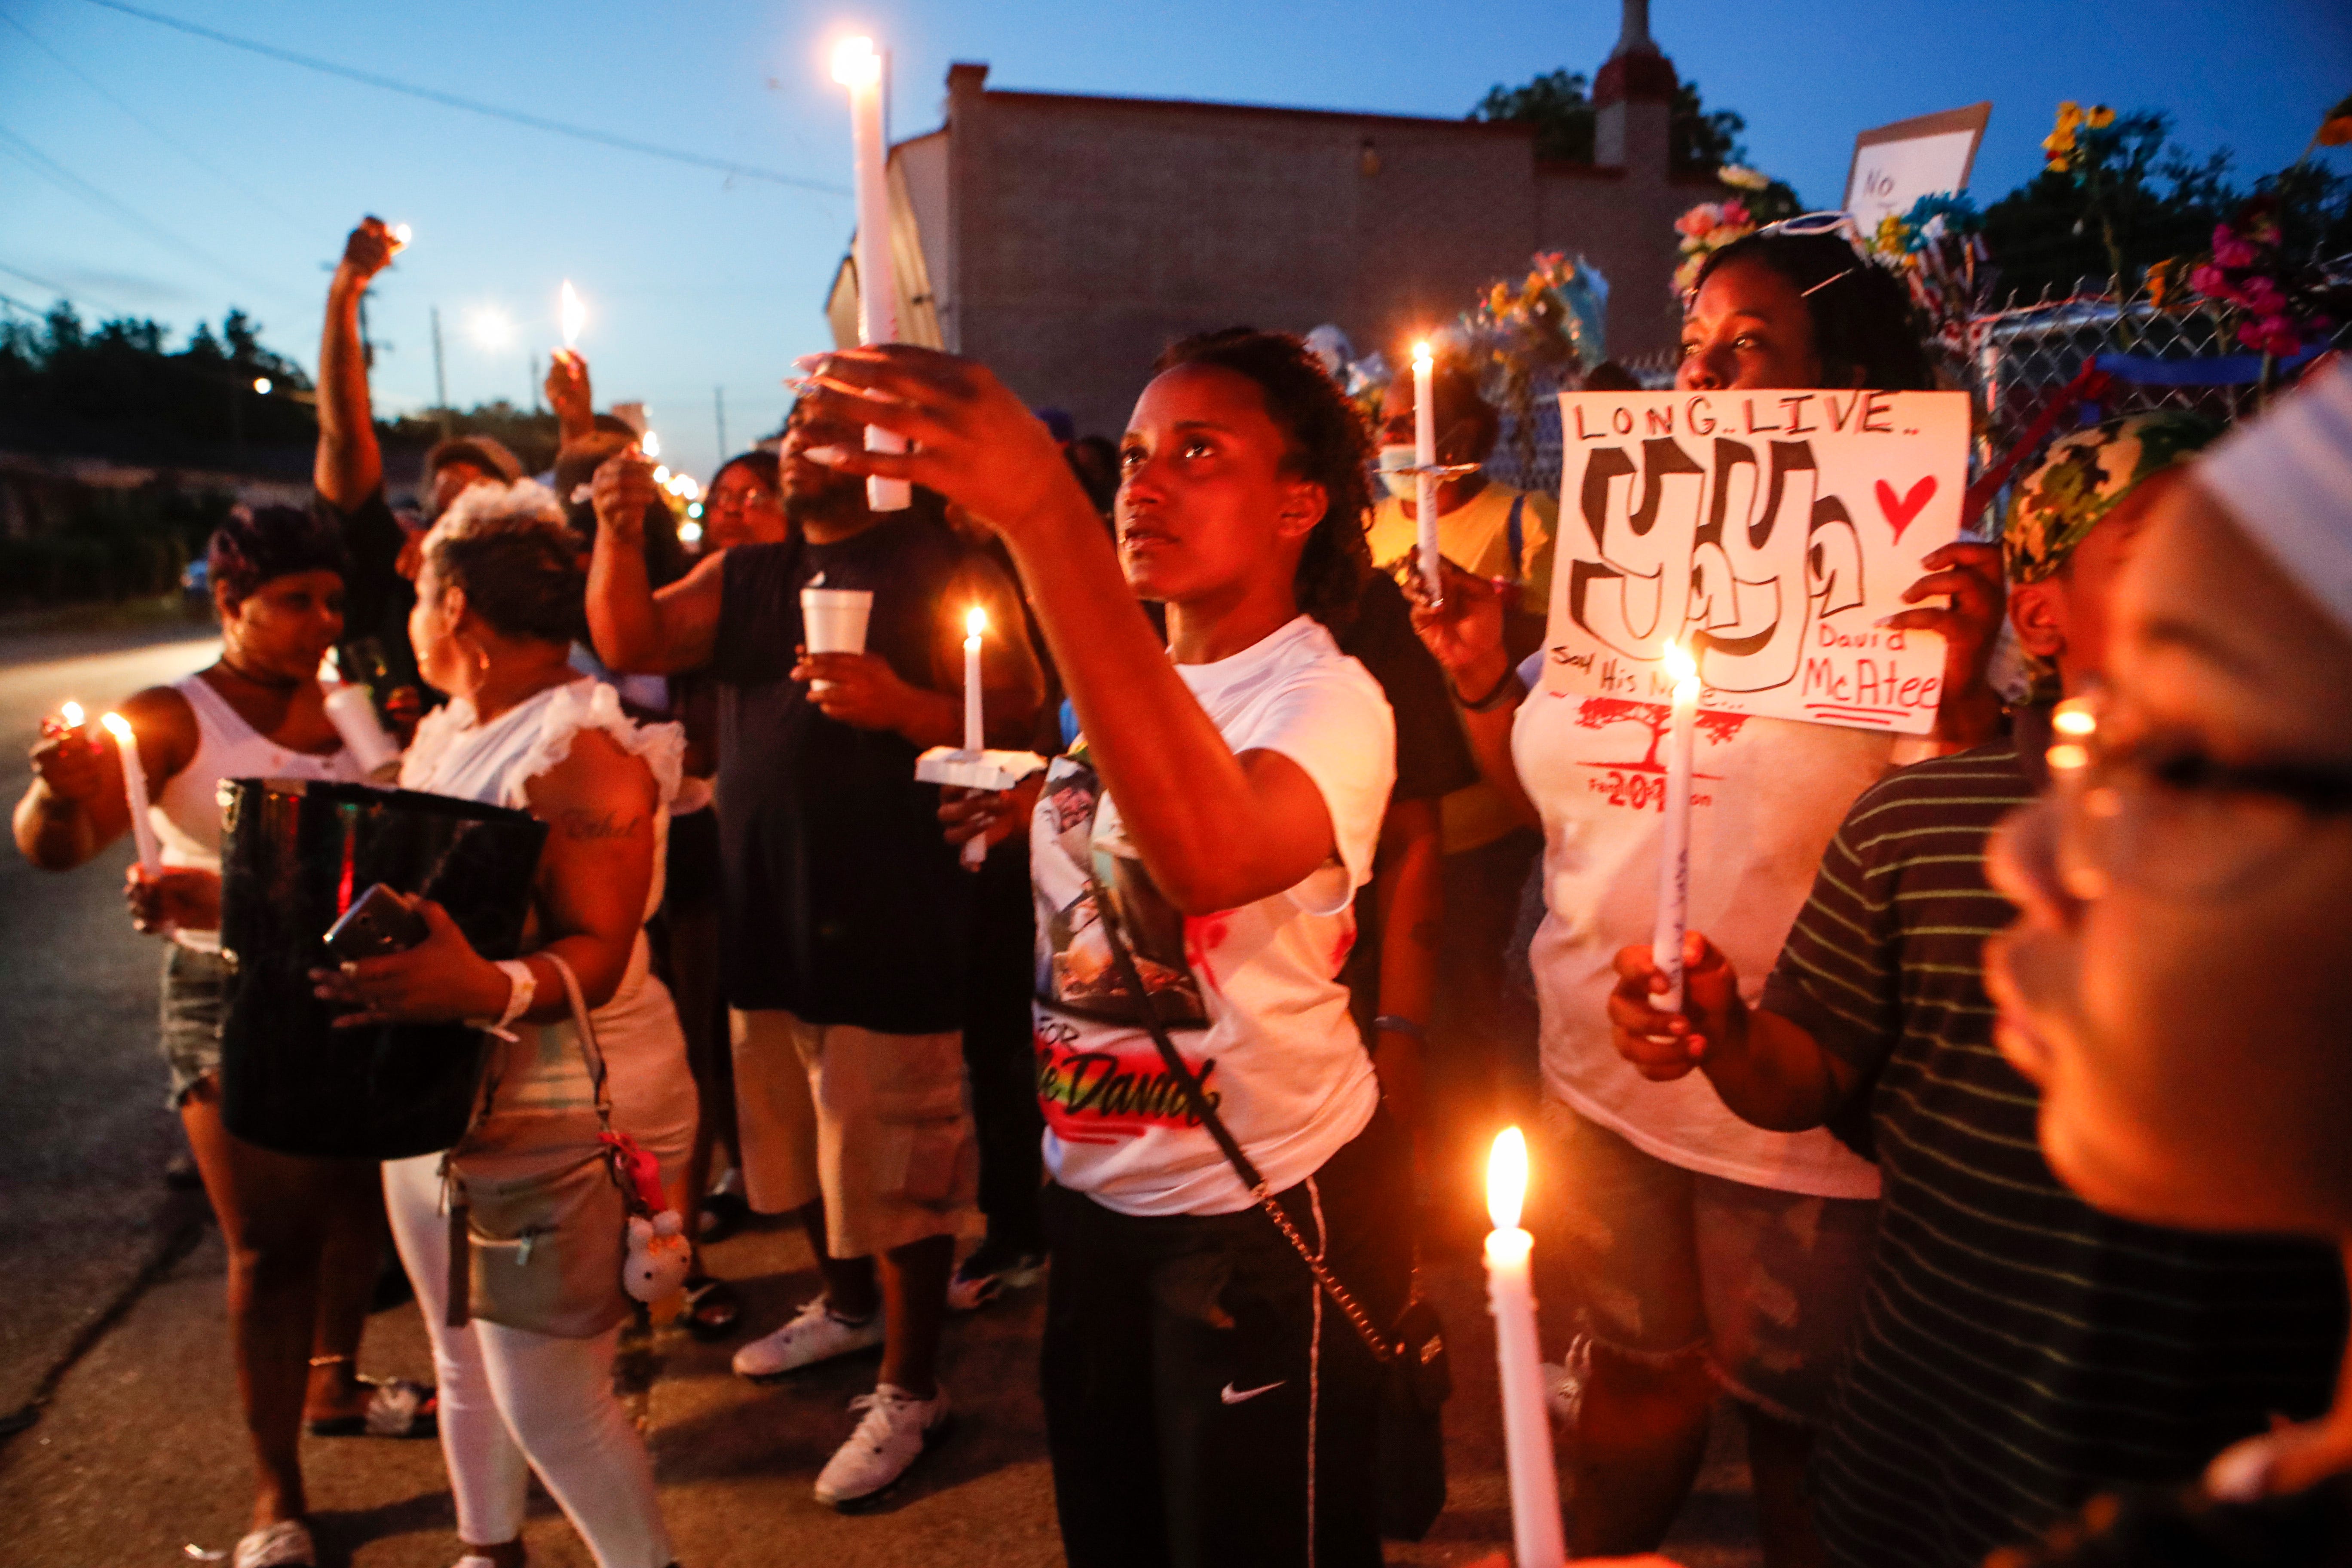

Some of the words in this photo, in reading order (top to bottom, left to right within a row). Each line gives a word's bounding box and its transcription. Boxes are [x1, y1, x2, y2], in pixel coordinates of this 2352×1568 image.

[1818, 623, 1907, 651] David
[1550, 646, 1596, 675] Say
[1599, 658, 1637, 692] His
[1801, 657, 1941, 709] McAtee
